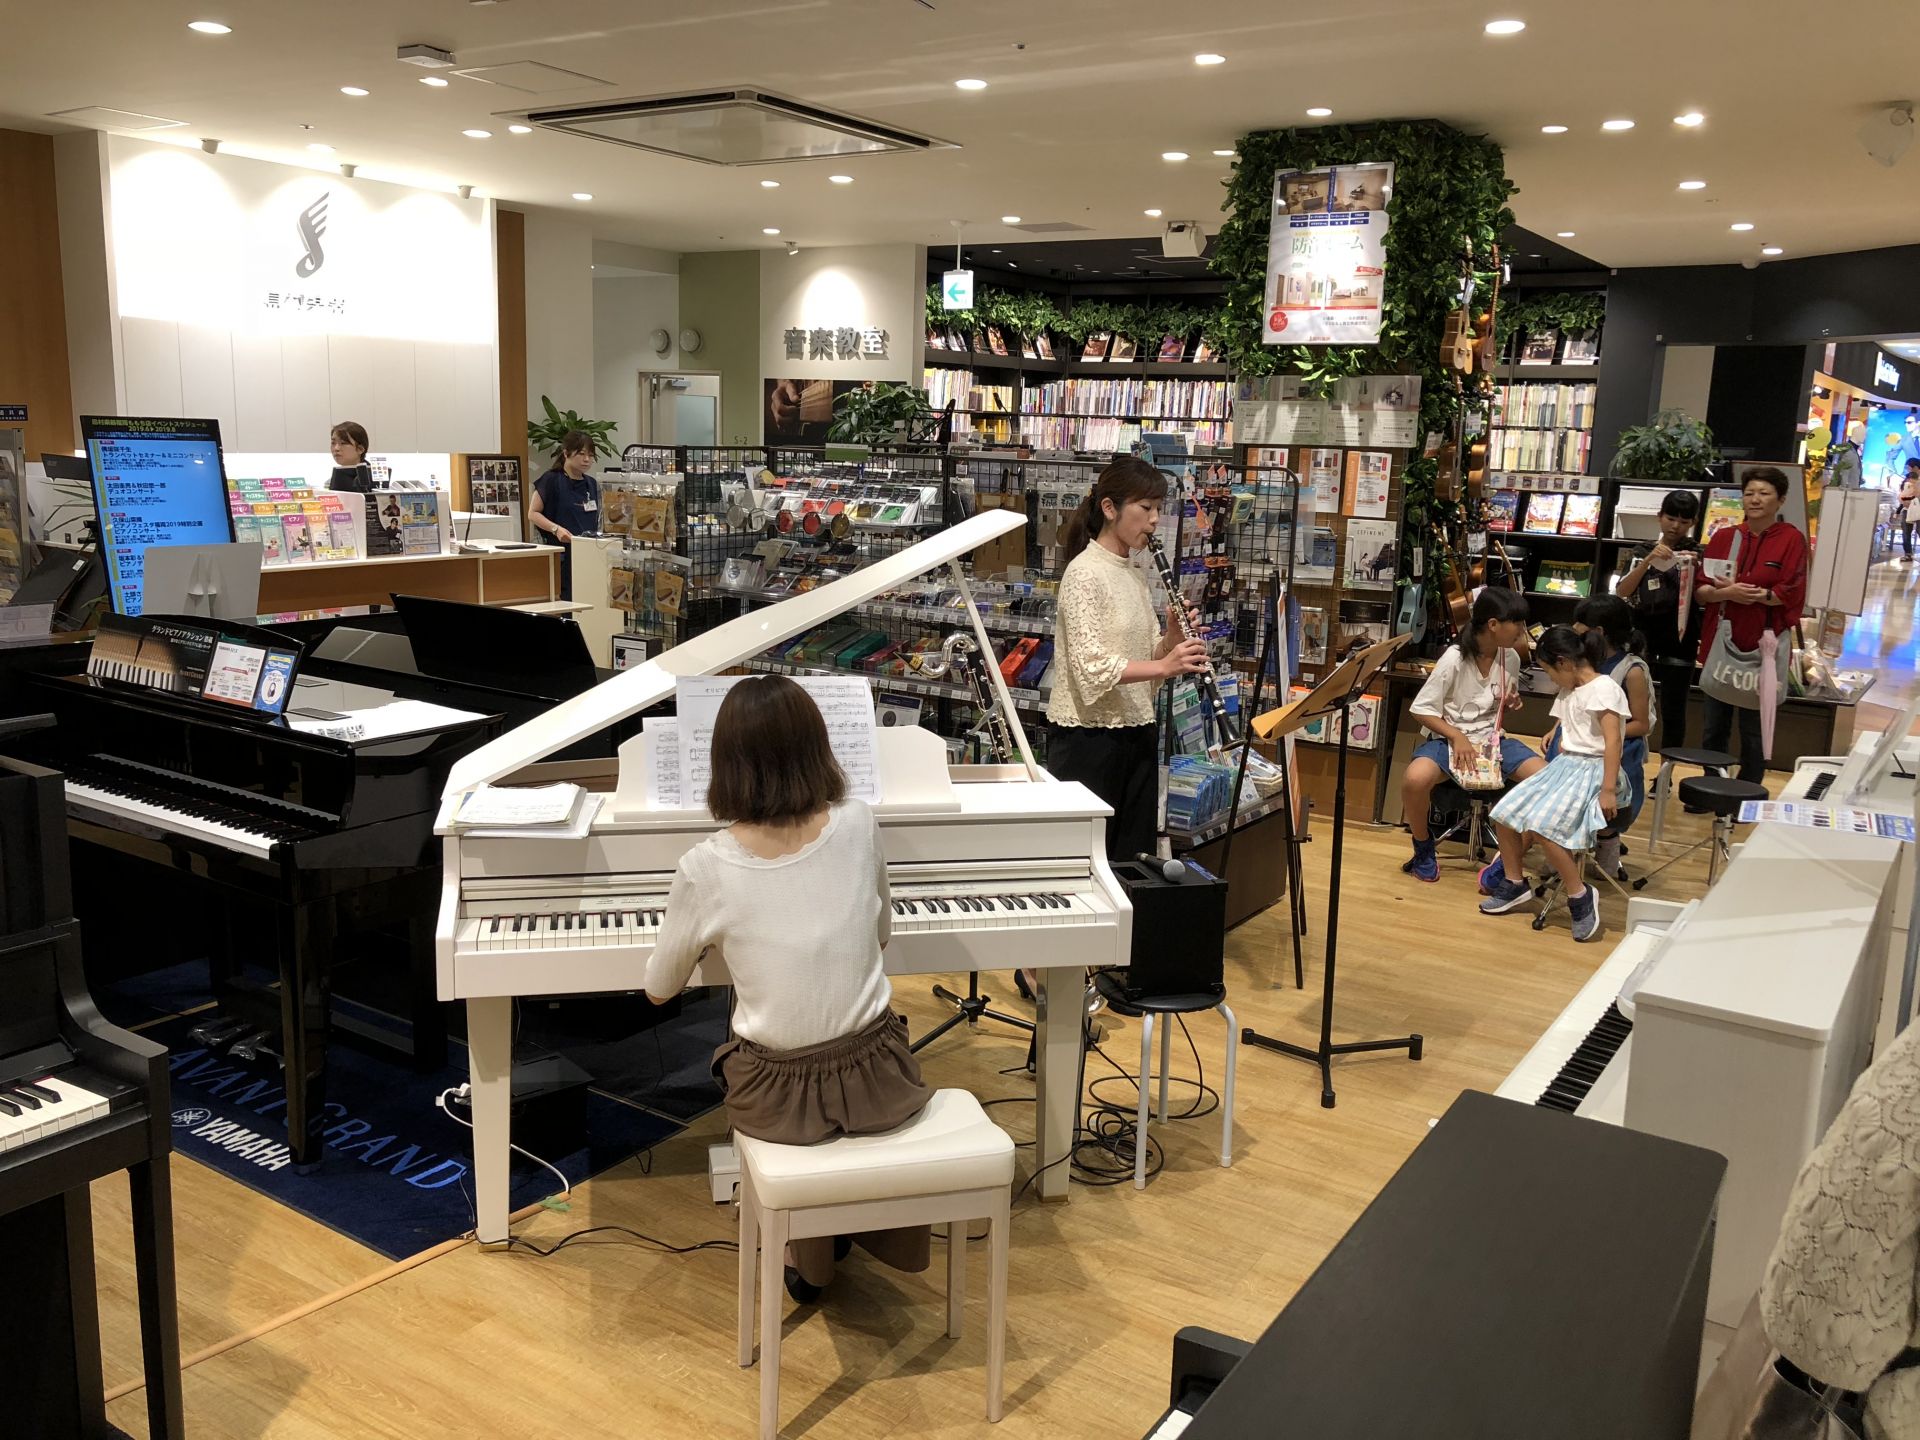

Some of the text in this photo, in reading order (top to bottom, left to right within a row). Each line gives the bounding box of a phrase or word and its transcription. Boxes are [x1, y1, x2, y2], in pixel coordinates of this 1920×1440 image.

[784, 326, 883, 355] 音楽教室
[190, 1116, 292, 1172] YAMAHA
